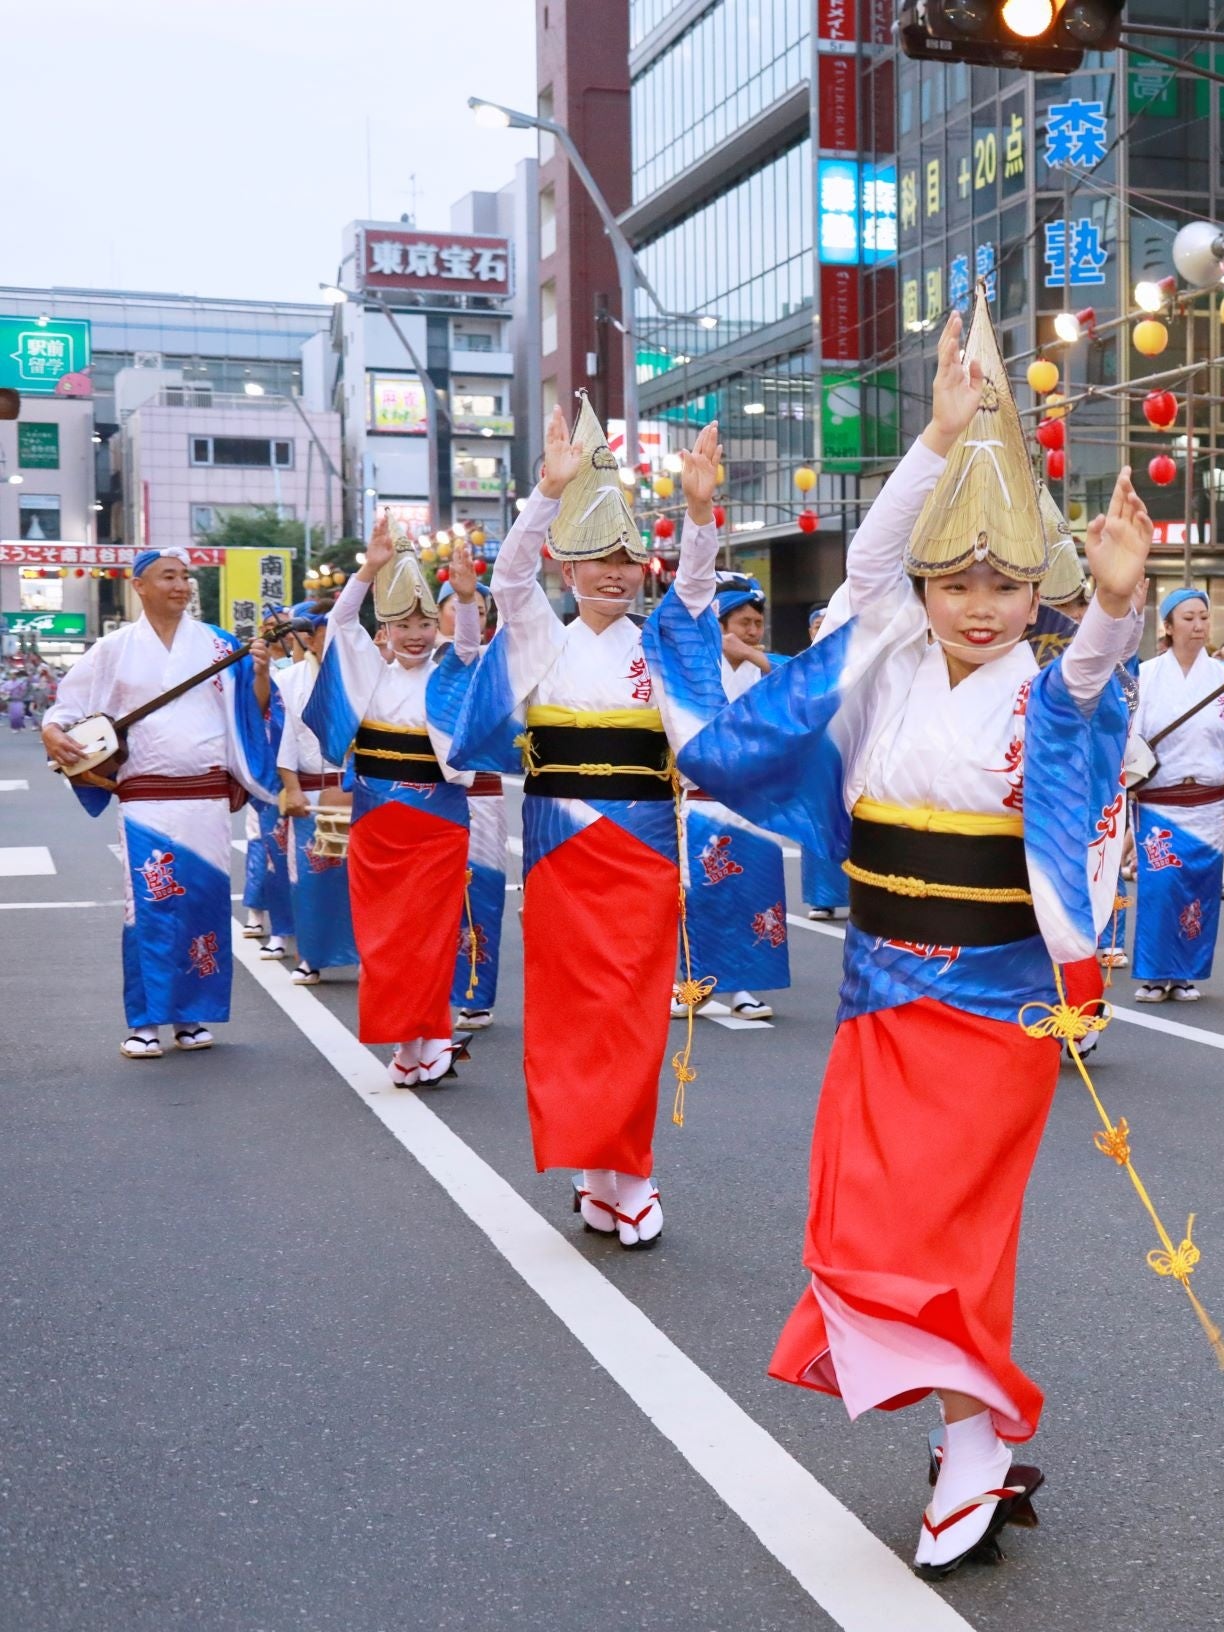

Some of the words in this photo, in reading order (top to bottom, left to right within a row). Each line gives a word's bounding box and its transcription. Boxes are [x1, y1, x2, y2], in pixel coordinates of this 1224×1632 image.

[1043, 98, 1109, 288] 森塾
[369, 240, 507, 282] 東京宝石
[26, 338, 65, 357] 駅前
